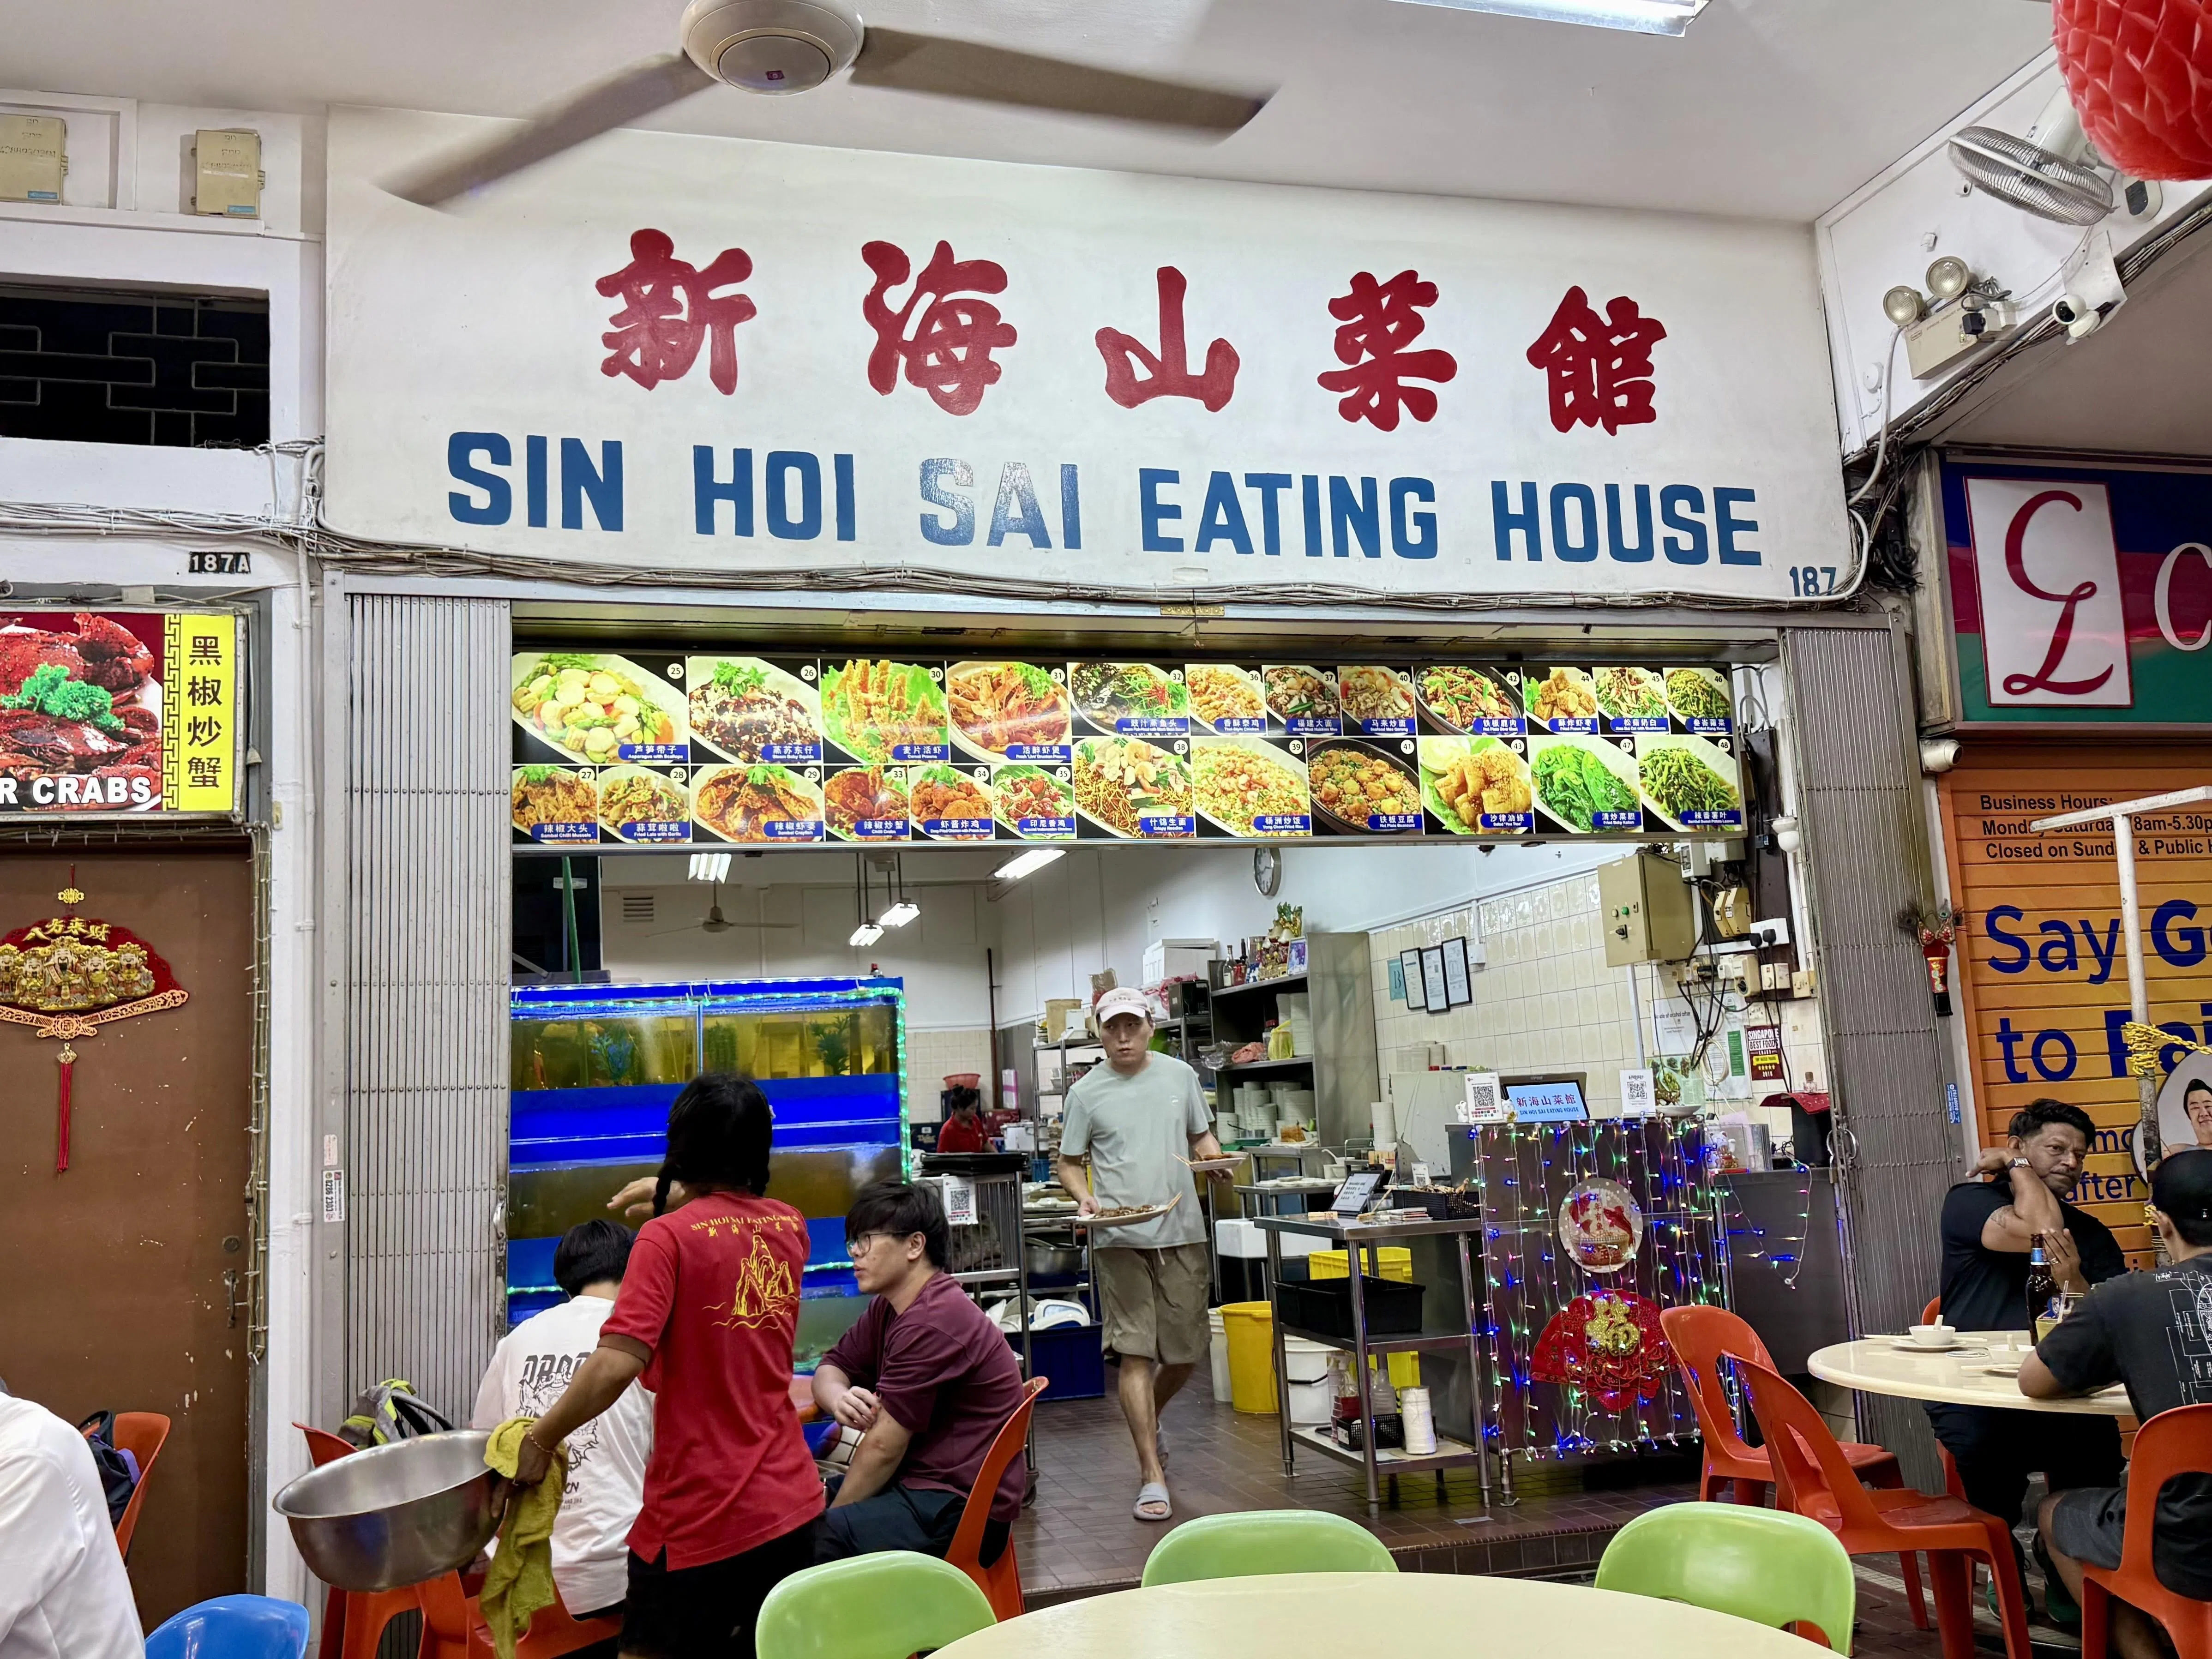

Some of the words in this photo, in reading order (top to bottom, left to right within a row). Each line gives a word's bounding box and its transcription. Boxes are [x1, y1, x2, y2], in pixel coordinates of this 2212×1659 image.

[595, 228, 1667, 435] 新海山菜館
[448, 431, 623, 531] SIN
[693, 445, 856, 541] HOI
[920, 457, 1081, 550] SAI
[1139, 467, 1438, 559] EATING
[1491, 480, 1761, 566] HOUSE
[192, 554, 249, 572] 187A
[1789, 566, 1836, 596] 187
[187, 635, 222, 788] 黑椒炒蟹
[634, 745, 677, 754] 芦笋带子
[582, 770, 591, 779] 27
[673, 770, 683, 779] 28
[807, 770, 817, 779] 29
[32, 777, 151, 805] CRABS
[1980, 795, 2056, 810] Business
[1986, 842, 2043, 859] Closed
[2048, 845, 2068, 857] on
[2073, 841, 2115, 856] Sund
[2139, 840, 2150, 854] &
[2155, 839, 2203, 854] Public
[1985, 904, 2121, 985] Say
[1393, 971, 1401, 989] B
[1749, 1040, 1761, 1049] BEST
[1996, 1017, 2077, 1083] to
[1516, 1094, 1576, 1107] 新海山菜館
[2065, 1171, 2135, 1202] after
[691, 1220, 709, 1230] SIN
[710, 1216, 729, 1226] HOI
